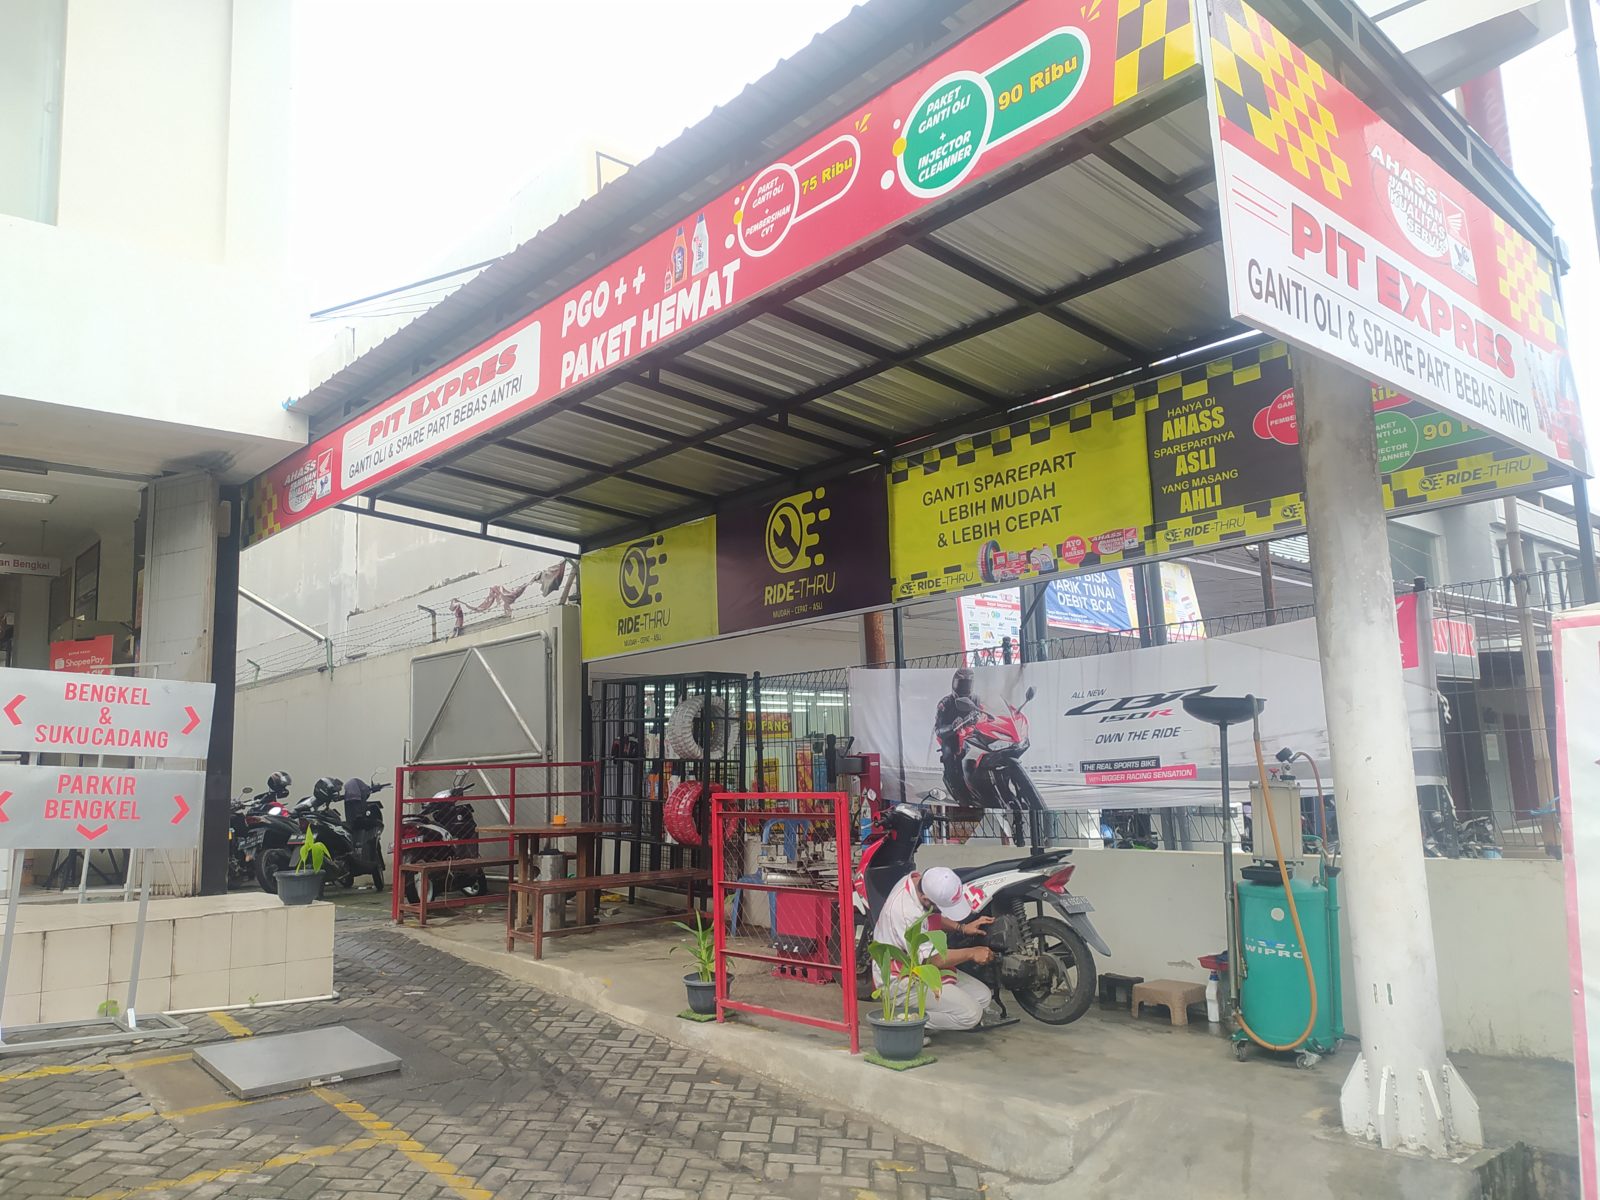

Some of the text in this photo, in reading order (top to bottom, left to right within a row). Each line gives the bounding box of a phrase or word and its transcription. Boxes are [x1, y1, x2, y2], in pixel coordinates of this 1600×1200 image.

[998, 55, 1078, 111] 90 Ribu
[926, 84, 962, 115] PAKET
[917, 95, 971, 135] GANTI OLI
[917, 129, 972, 171] INJECTOR
[939, 132, 947, 141] +
[801, 156, 854, 195] 75 Ribu
[917, 144, 972, 184] CLEANNER
[1370, 144, 1439, 205] AHASS
[752, 183, 784, 209] GANTI OLI
[757, 176, 779, 195] PAKET
[1388, 174, 1443, 224] JAMINAN
[745, 204, 791, 238] PEMBERSIHAN
[760, 223, 775, 238] CVT
[1290, 202, 1516, 379] PIT EXPRES
[560, 279, 610, 338] PGO
[560, 314, 637, 390] PAKET
[640, 258, 741, 349] HEMAT
[1246, 257, 1532, 434] GANTI OLI & SPARE PART BEBAS ANTRI
[367, 342, 519, 447] PIT EXPRES
[1167, 396, 1216, 418] HANYA DI
[348, 374, 523, 479] GANTI OLI & SPARE PART BEBAS ANTRI
[1162, 406, 1225, 442] AHASS
[1392, 427, 1407, 435] OLI
[1423, 420, 1452, 441] 90
[1153, 430, 1235, 459] SPAREPARTNYA
[284, 459, 317, 486] AHASS
[1175, 446, 1216, 477] ASLI
[1445, 458, 1532, 487] RIDE-THRU
[922, 451, 1077, 507] GANTI SPAREPART
[1161, 469, 1239, 495] YANG MASANG
[939, 481, 1056, 525] LEBIH MUDAH
[1180, 484, 1222, 514] AHLI
[937, 505, 1063, 548] & LEBIH CEPAT
[1183, 516, 1246, 538] RIDE-THRU
[13, 559, 50, 571] Bengkel
[764, 571, 836, 606] RIDE-THRU
[917, 571, 974, 591] RIDE-THRU
[1082, 582, 1116, 600] TUNAI
[772, 609, 791, 619] MUDAH
[794, 606, 809, 616] CEPAT
[1057, 592, 1089, 610] DEBIT
[1090, 598, 1115, 614] BCA
[617, 607, 671, 637] RIDE-THRU
[64, 682, 152, 707] BENGKEL
[1071, 687, 1107, 700] ALL NEW
[98, 707, 113, 726] &
[1098, 708, 1175, 724] 150R
[1095, 726, 1181, 745] OWN THE RIDE
[1082, 763, 1097, 772] THE
[1097, 762, 1113, 771] REAL
[1113, 760, 1139, 770] SPORTS
[1139, 759, 1157, 768] BIKE
[1101, 773, 1128, 783] BIGGER
[1128, 771, 1155, 781] RACING
[1156, 768, 1193, 779] SENSATION
[57, 774, 138, 796] PARKIR
[44, 799, 142, 821] BENGKEL
